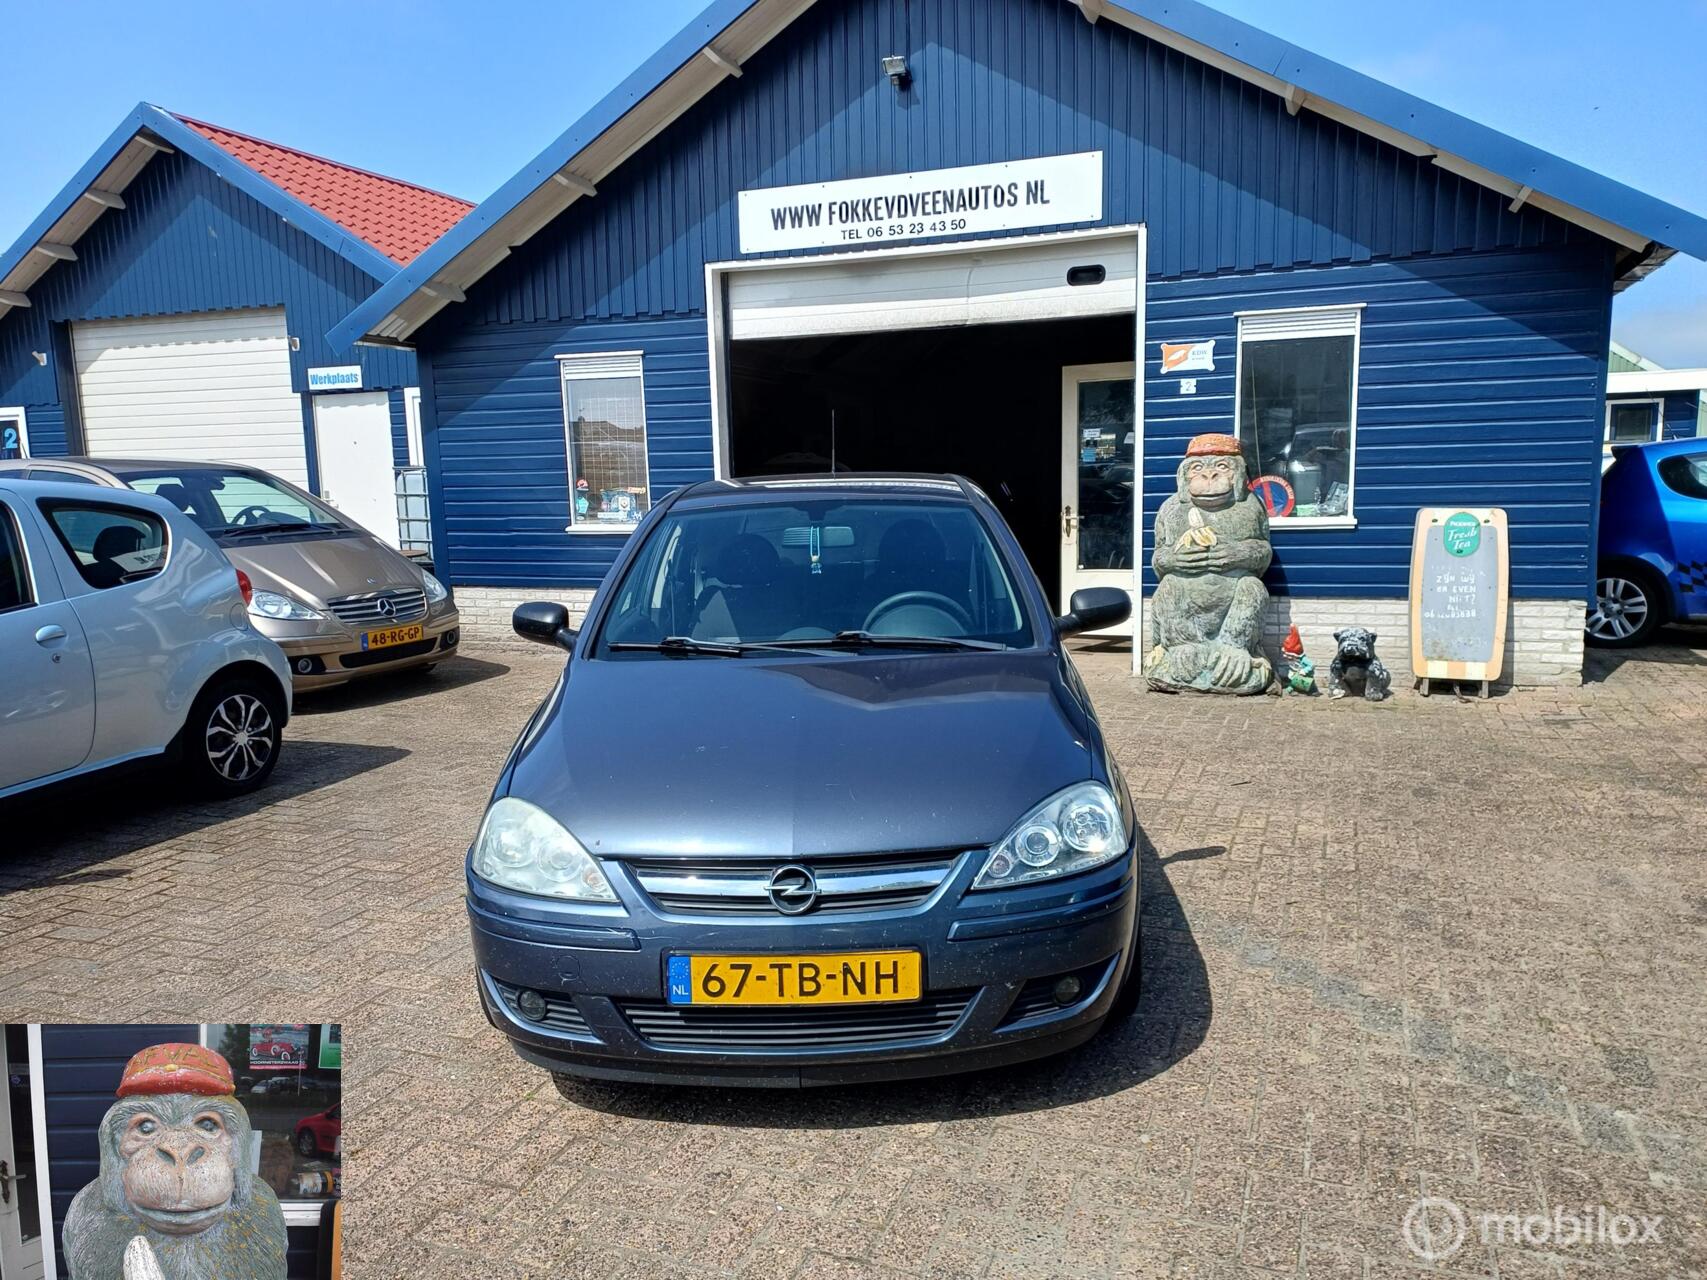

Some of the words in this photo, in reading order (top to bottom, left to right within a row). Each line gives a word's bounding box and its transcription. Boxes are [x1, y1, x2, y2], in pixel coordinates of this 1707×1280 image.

[771, 203, 822, 231] WWW
[828, 182, 1018, 226] FOKKEVDVEENAUTOS
[1026, 179, 1050, 206] NL
[841, 229, 863, 240] TEL
[867, 226, 883, 238] 06
[888, 224, 904, 236] 53
[909, 222, 924, 235] 23
[929, 220, 947, 232] 43
[950, 218, 967, 231] 50
[310, 372, 359, 386] Werkplaats
[1185, 381, 1192, 391] 2
[4, 427, 18, 449] 2
[371, 626, 420, 646] 48-RG-GP
[672, 984, 689, 996] NL
[701, 960, 899, 998] 67-TB-NH
